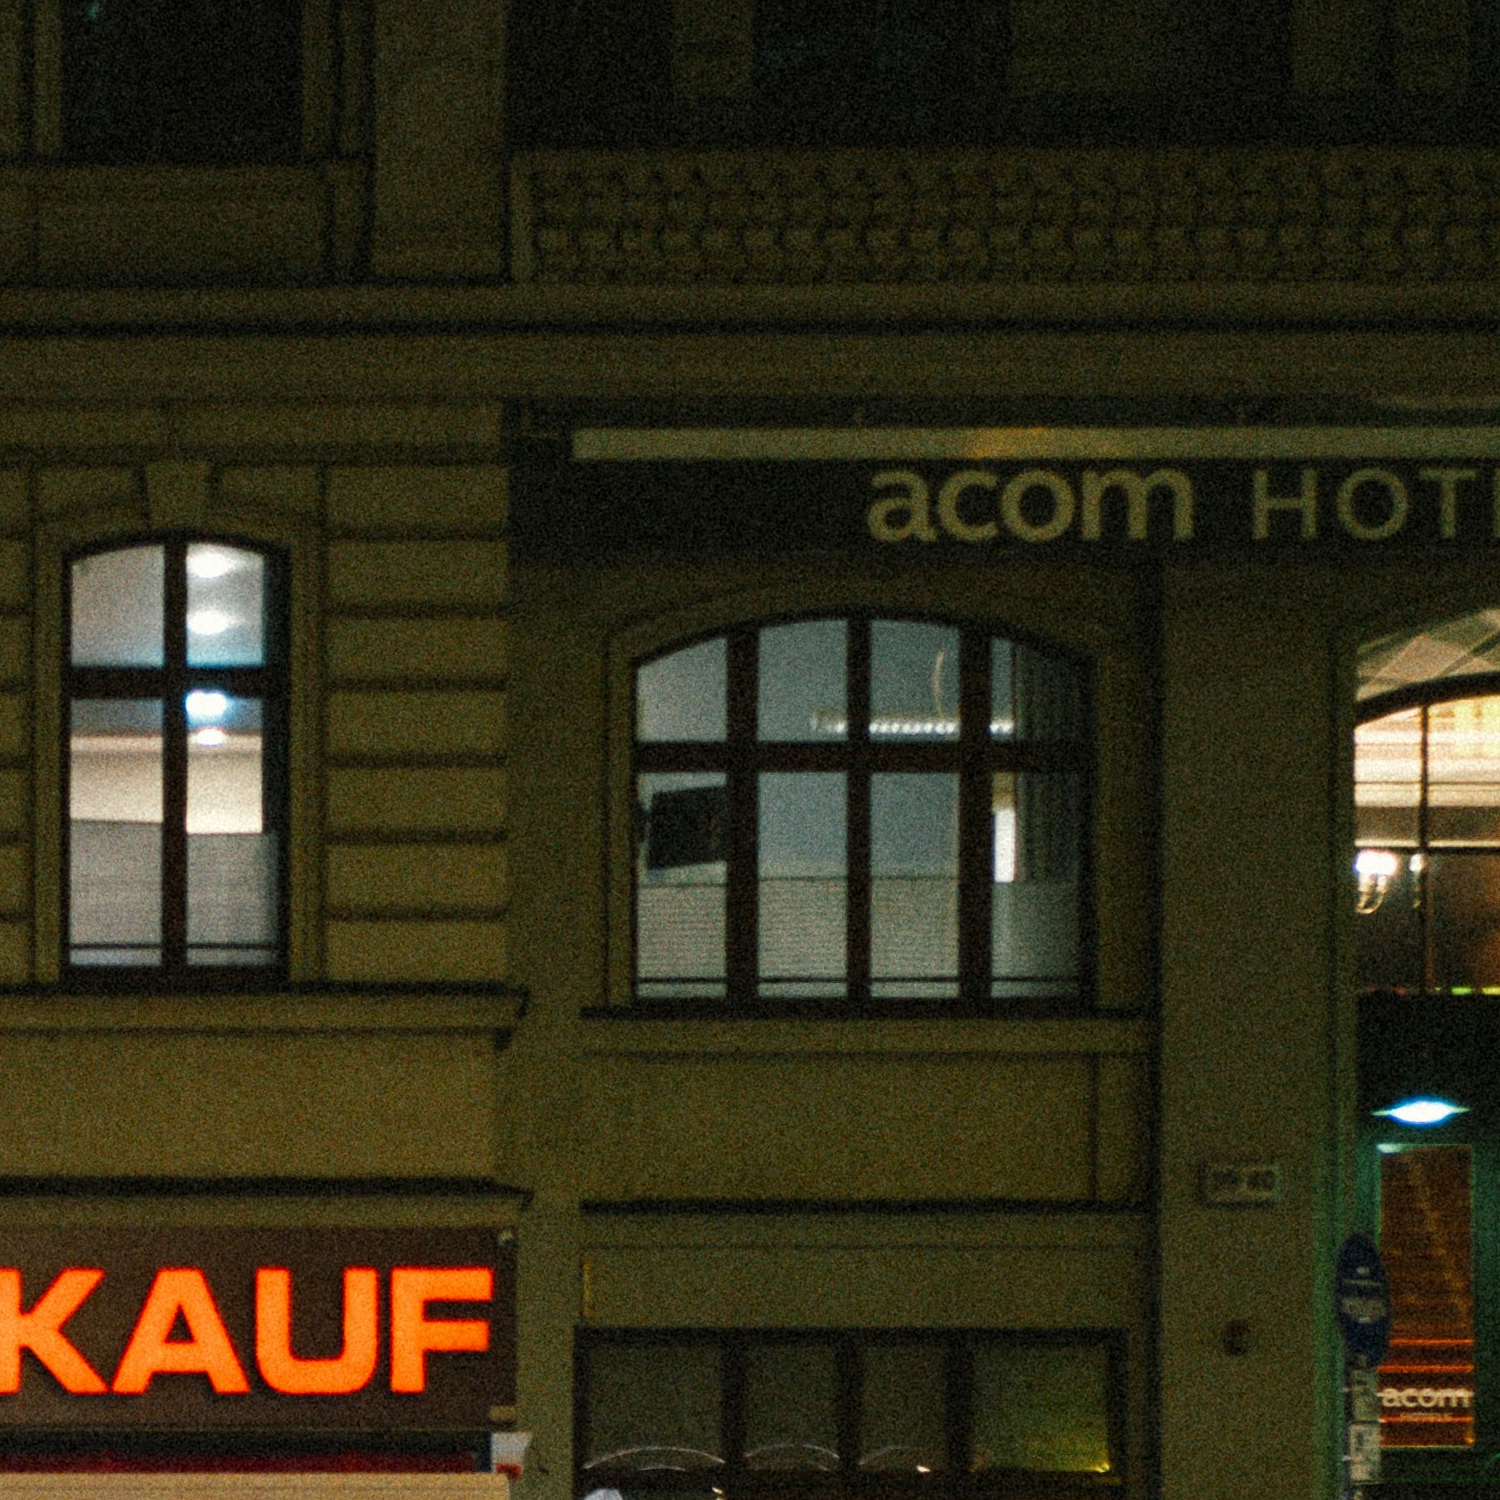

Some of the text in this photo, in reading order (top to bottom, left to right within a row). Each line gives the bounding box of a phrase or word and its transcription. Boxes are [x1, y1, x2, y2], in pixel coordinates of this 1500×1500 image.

[867, 468, 1500, 543] acom HOT
[1382, 1387, 1470, 1408] acom
